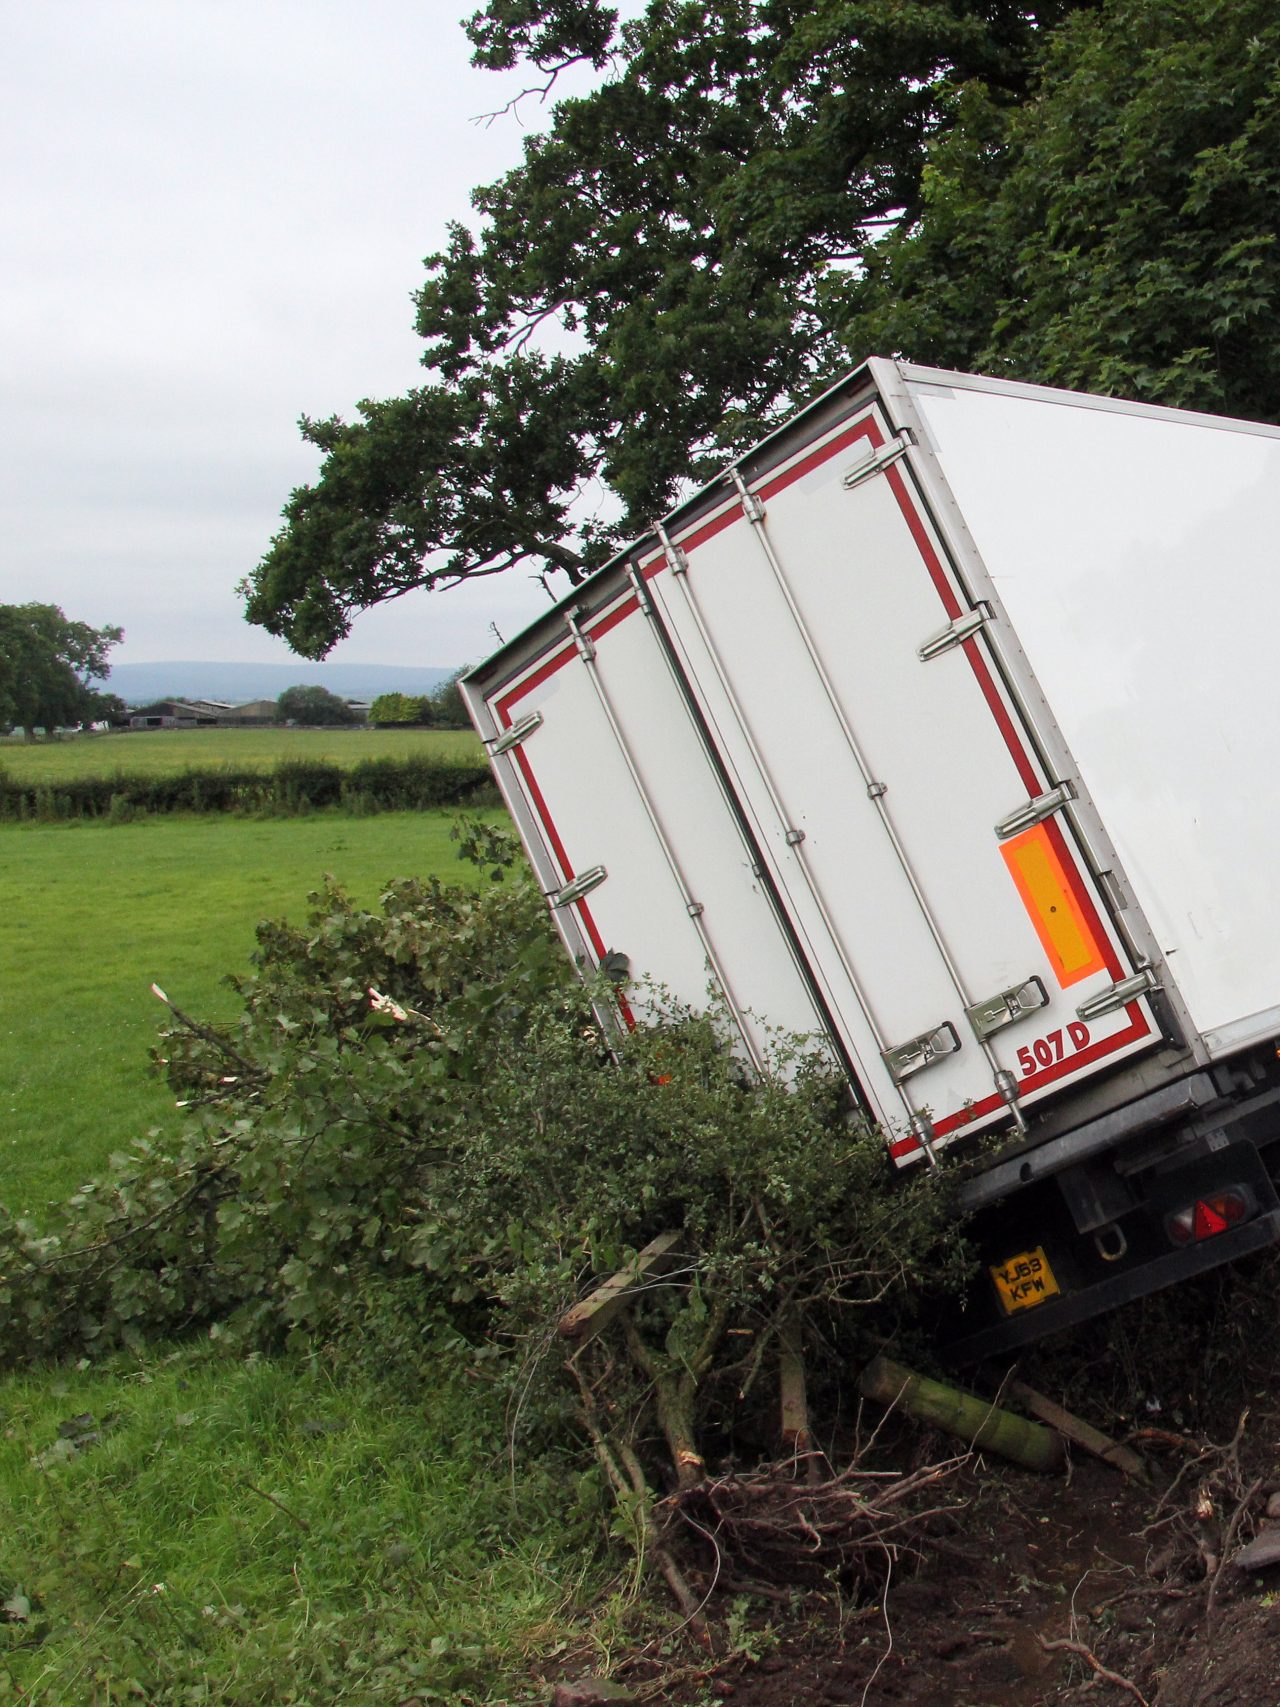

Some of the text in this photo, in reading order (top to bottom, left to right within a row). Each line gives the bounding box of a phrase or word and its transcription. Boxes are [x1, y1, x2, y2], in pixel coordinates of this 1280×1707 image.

[1016, 1021, 1090, 1076] 507 D
[999, 1258, 1042, 1285] YJ53
[1010, 1276, 1045, 1301] KFW
